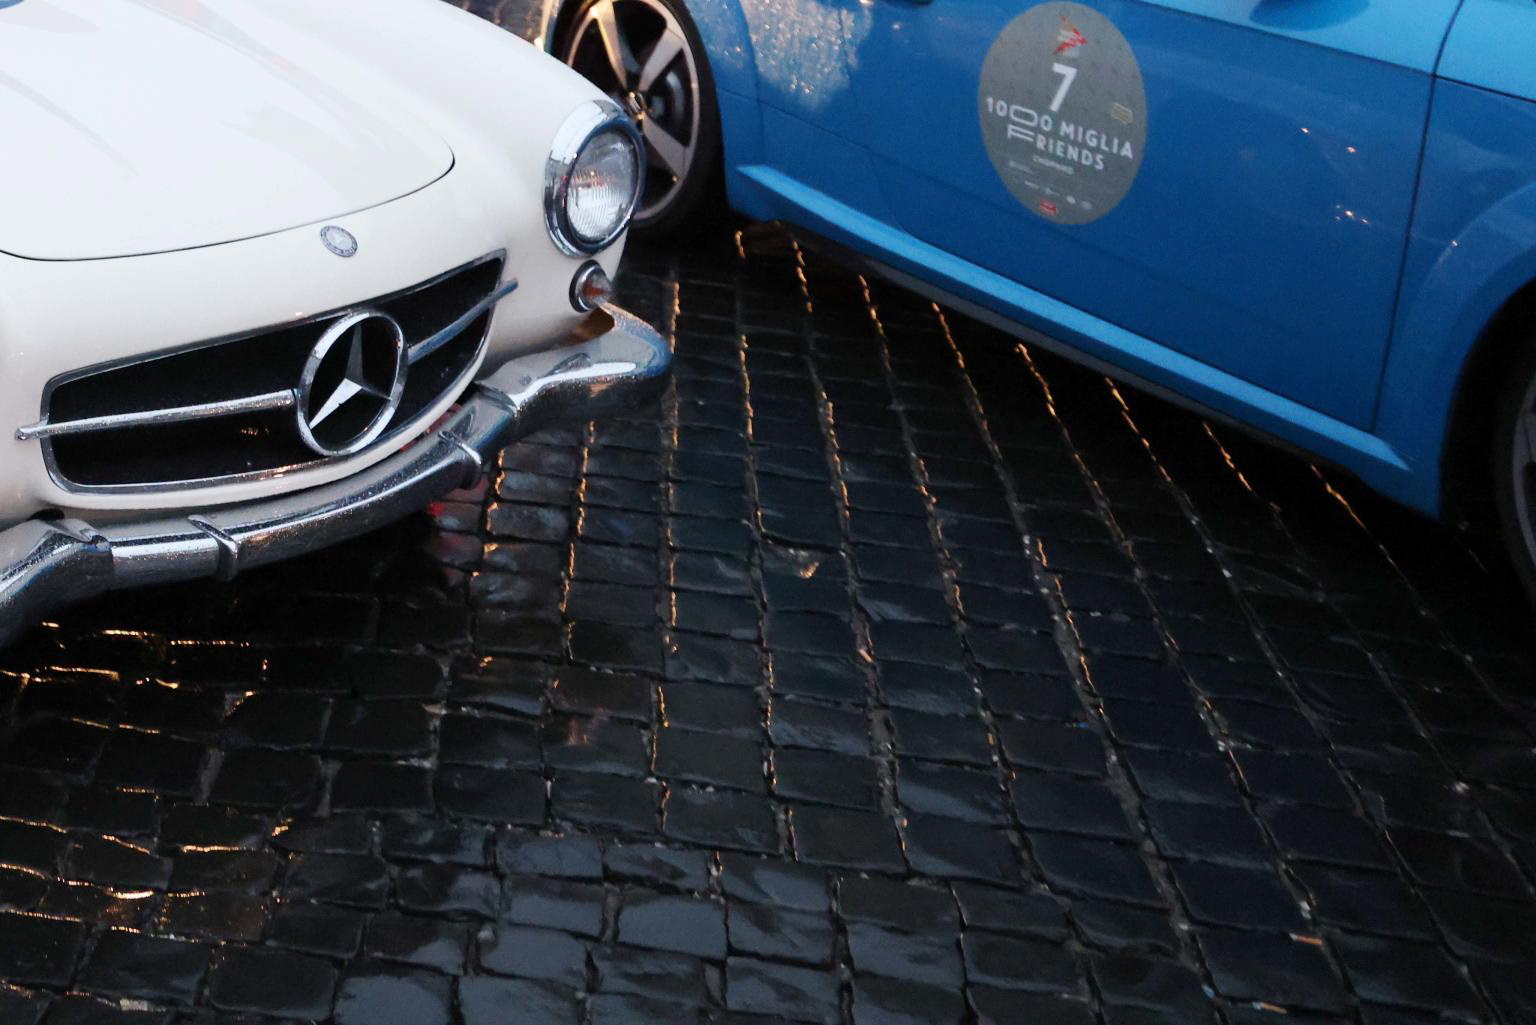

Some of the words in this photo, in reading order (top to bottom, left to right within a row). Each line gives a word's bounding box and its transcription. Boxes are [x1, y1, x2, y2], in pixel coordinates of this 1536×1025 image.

[1049, 62, 1078, 112] 7
[986, 96, 1053, 132] 1000
[1060, 121, 1133, 160] MIGLIA
[1007, 124, 1105, 171] FRIENDS
